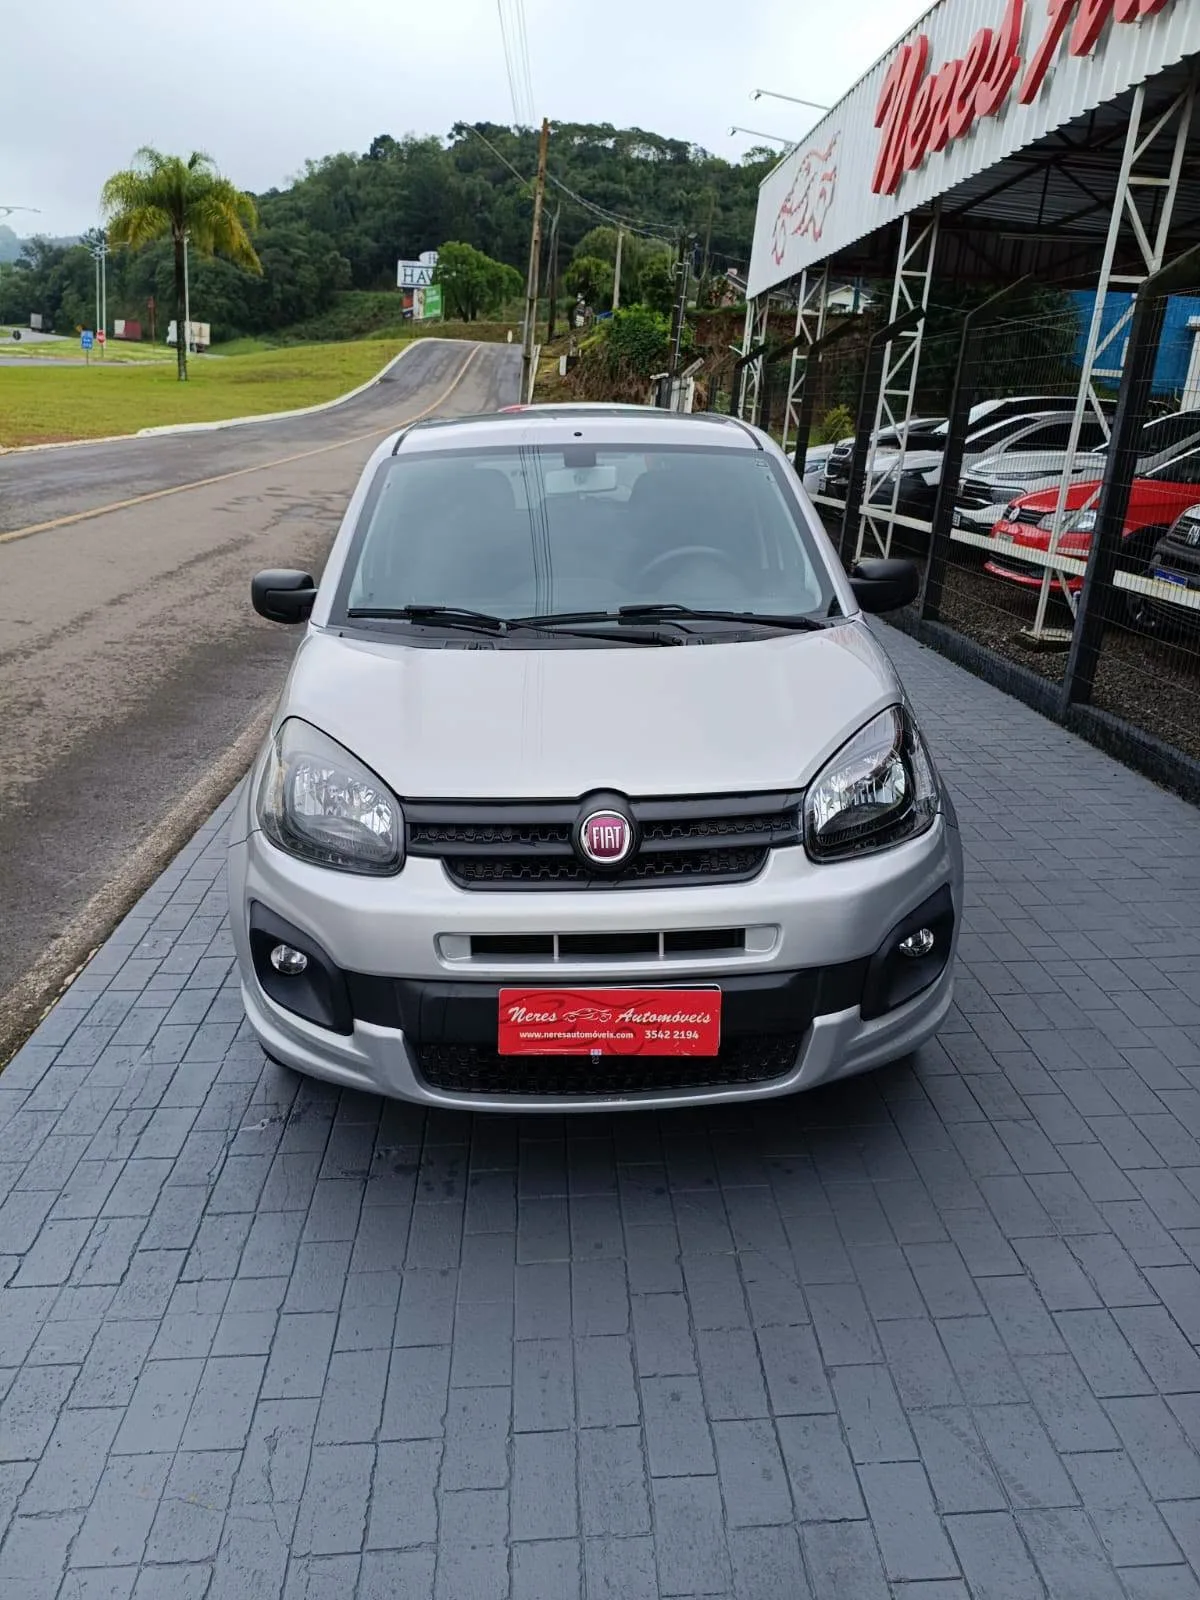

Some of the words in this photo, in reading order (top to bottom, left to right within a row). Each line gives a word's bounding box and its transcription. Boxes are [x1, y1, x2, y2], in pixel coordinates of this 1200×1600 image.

[592, 826, 622, 849] FIAT
[508, 1006, 558, 1023] Neres
[615, 1007, 712, 1024] Automóveis
[644, 1029, 670, 1039] 3542
[673, 1029, 699, 1040] 2194
